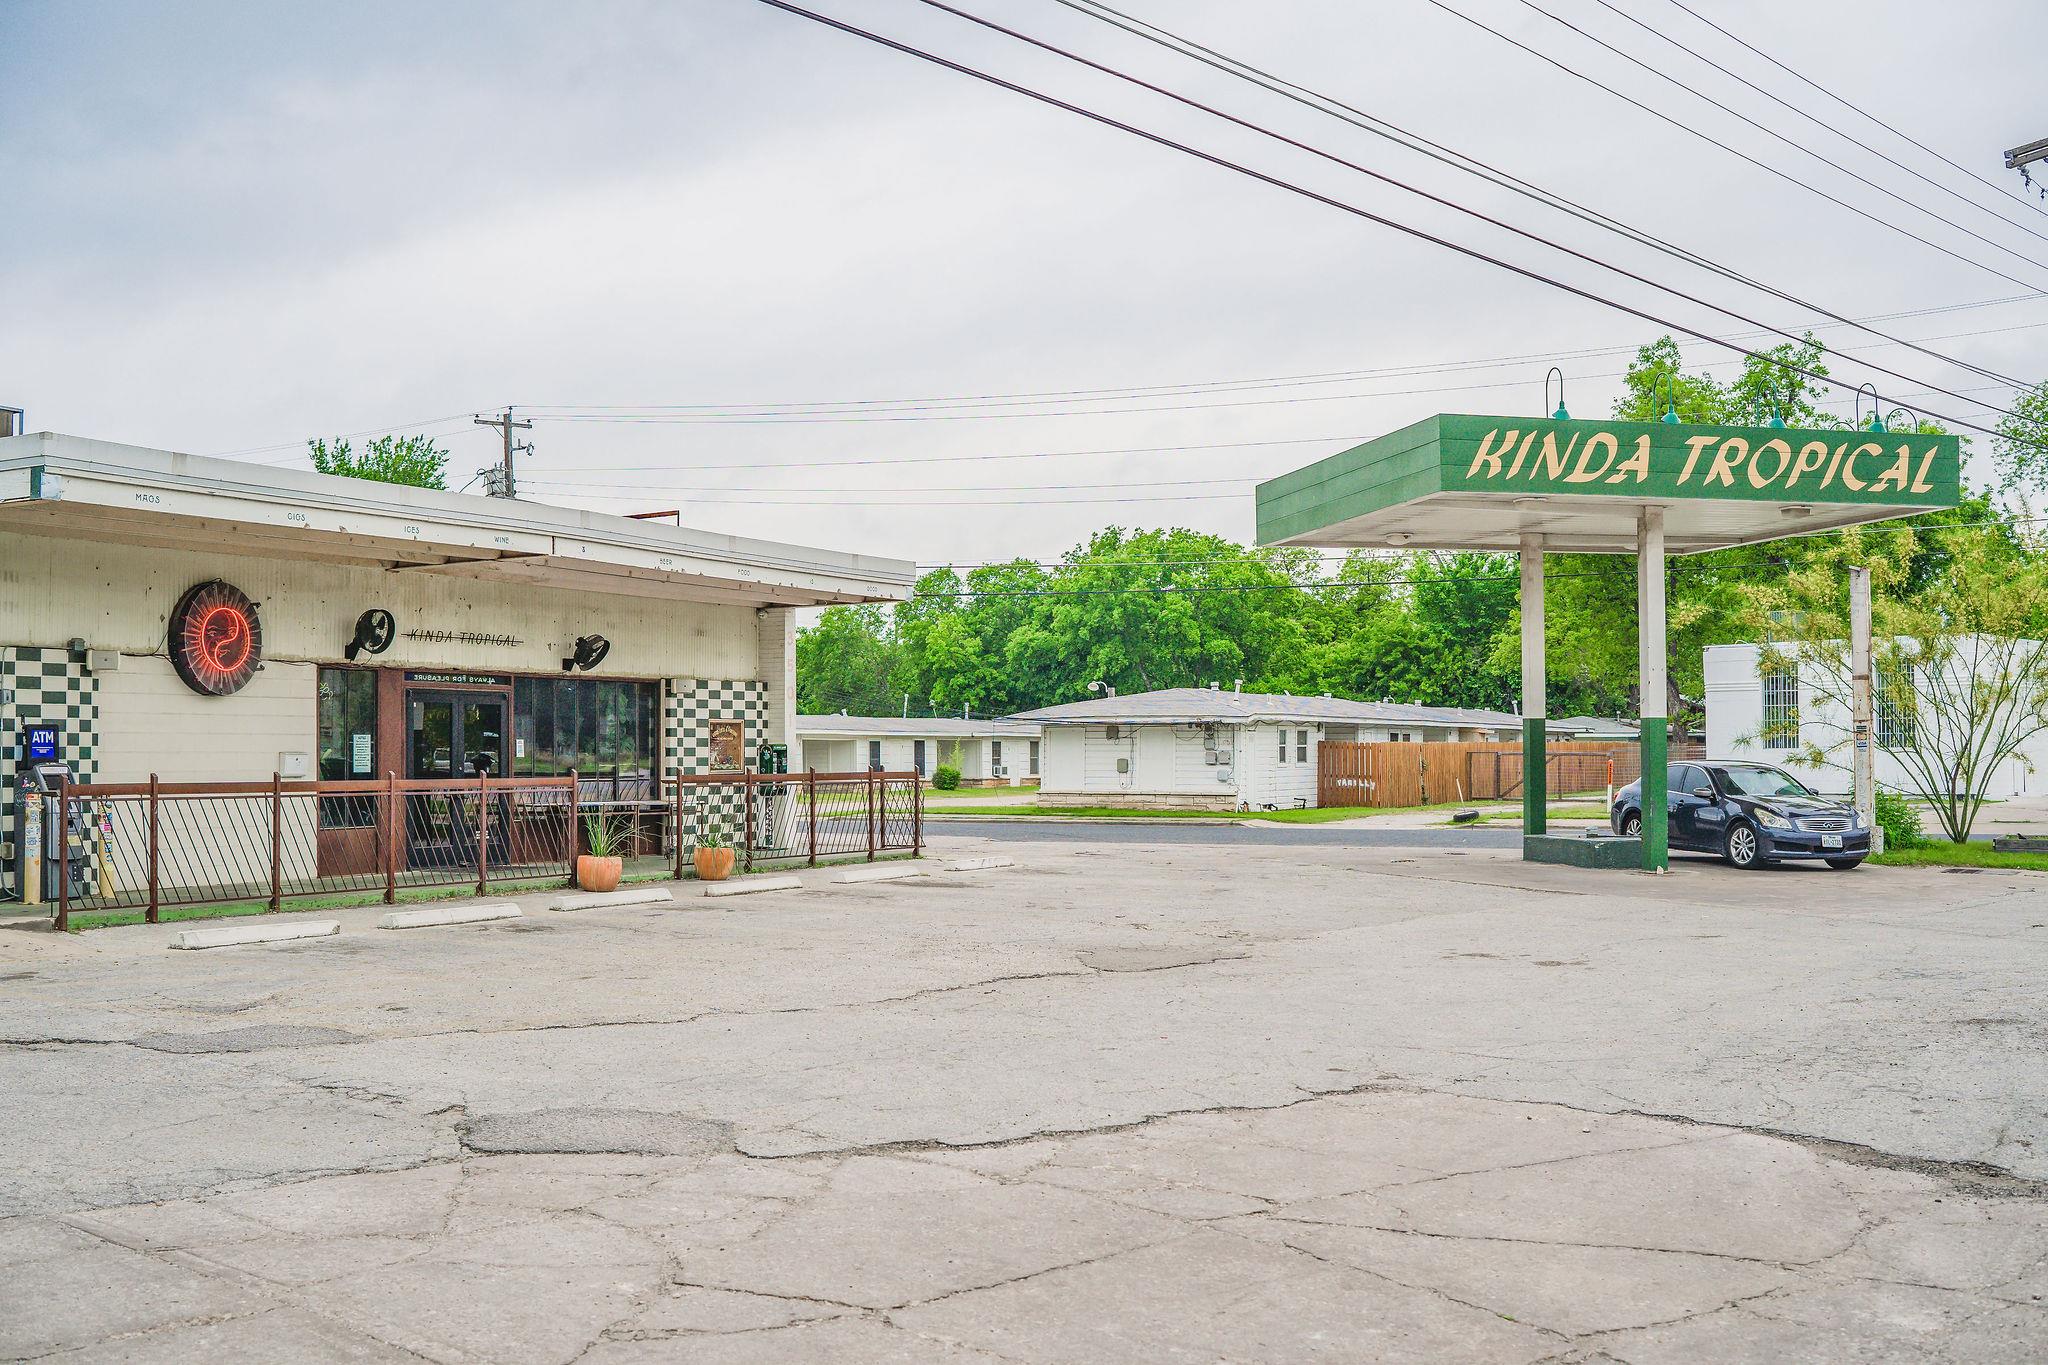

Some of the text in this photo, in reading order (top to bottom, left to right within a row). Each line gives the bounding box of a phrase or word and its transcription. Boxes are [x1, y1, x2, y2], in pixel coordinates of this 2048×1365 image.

[1465, 428, 1939, 494] KINDA TROPICAL
[135, 493, 161, 504] MAGS
[494, 535, 510, 545] WINE
[410, 628, 518, 647] KINDA TROPICAL
[32, 731, 54, 743] ATM
